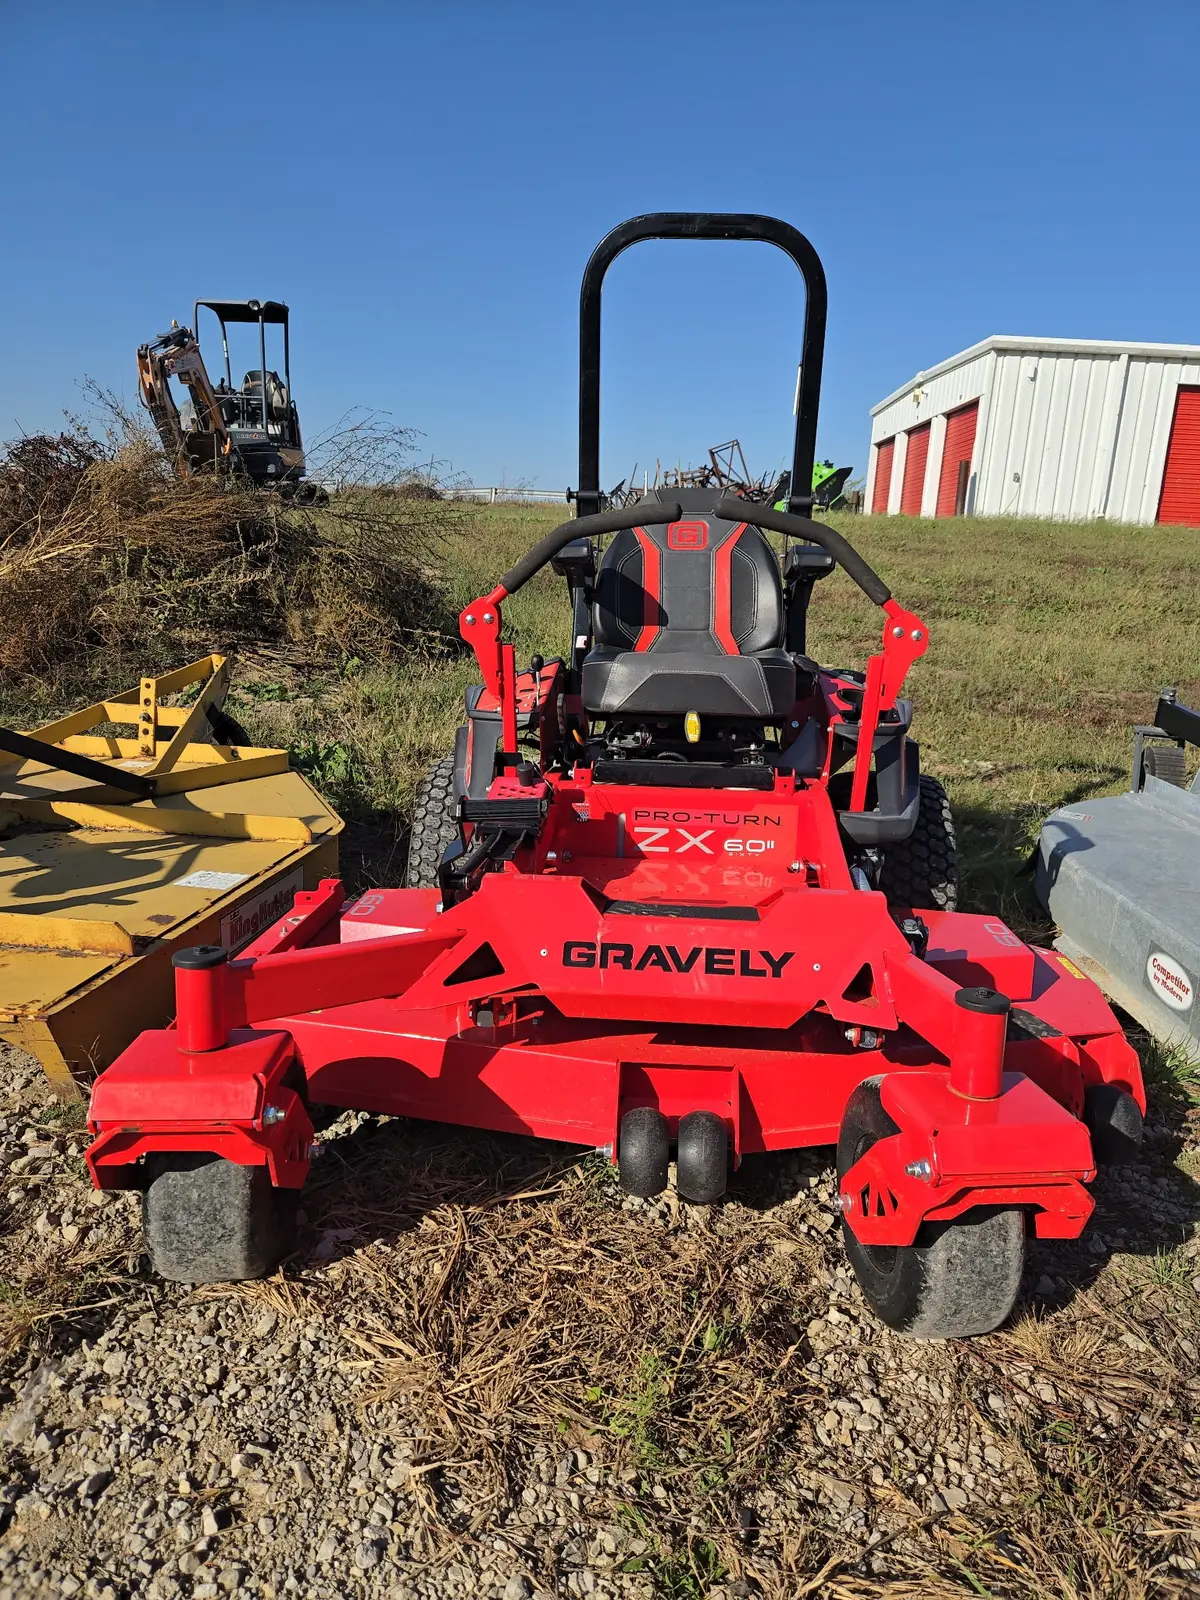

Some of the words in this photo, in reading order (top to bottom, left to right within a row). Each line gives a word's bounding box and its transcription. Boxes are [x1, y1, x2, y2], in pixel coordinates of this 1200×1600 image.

[634, 810, 782, 827] PRO-TURN
[632, 826, 717, 855] ZX
[562, 940, 796, 979] GRAVELY
[1152, 957, 1191, 995] Competitor
[1153, 972, 1161, 984] by
[1160, 979, 1183, 1003] Modern
